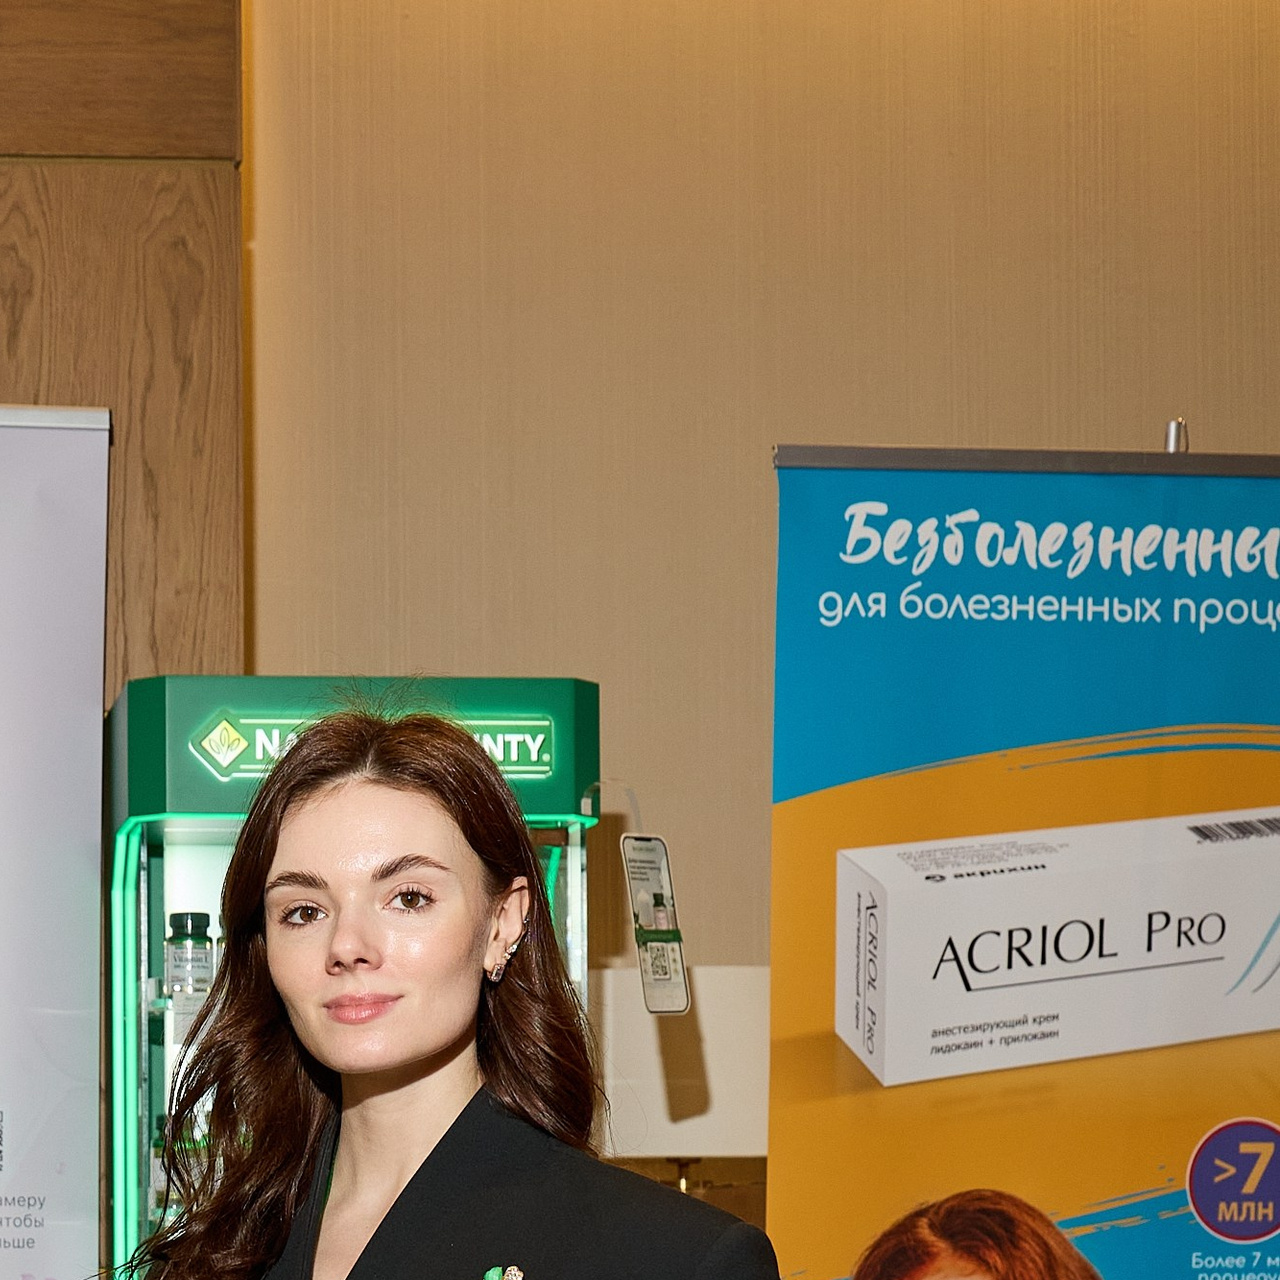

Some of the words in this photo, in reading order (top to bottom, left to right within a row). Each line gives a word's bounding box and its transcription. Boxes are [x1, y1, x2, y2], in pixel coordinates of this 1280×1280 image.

[818, 589, 887, 628] для
[900, 583, 1162, 623] болезненных
[1174, 595, 1280, 634] проц
[931, 917, 1119, 994] ACRIOL
[931, 1014, 1030, 1041] анестезирующий
[1032, 1010, 1060, 1027] крем
[931, 1038, 985, 1056] лидокаин
[998, 1028, 1060, 1049] прилокаин
[1217, 1202, 1275, 1223] МЛН
[1192, 1250, 1247, 1270] Более
[1252, 1251, 1262, 1268] 7
